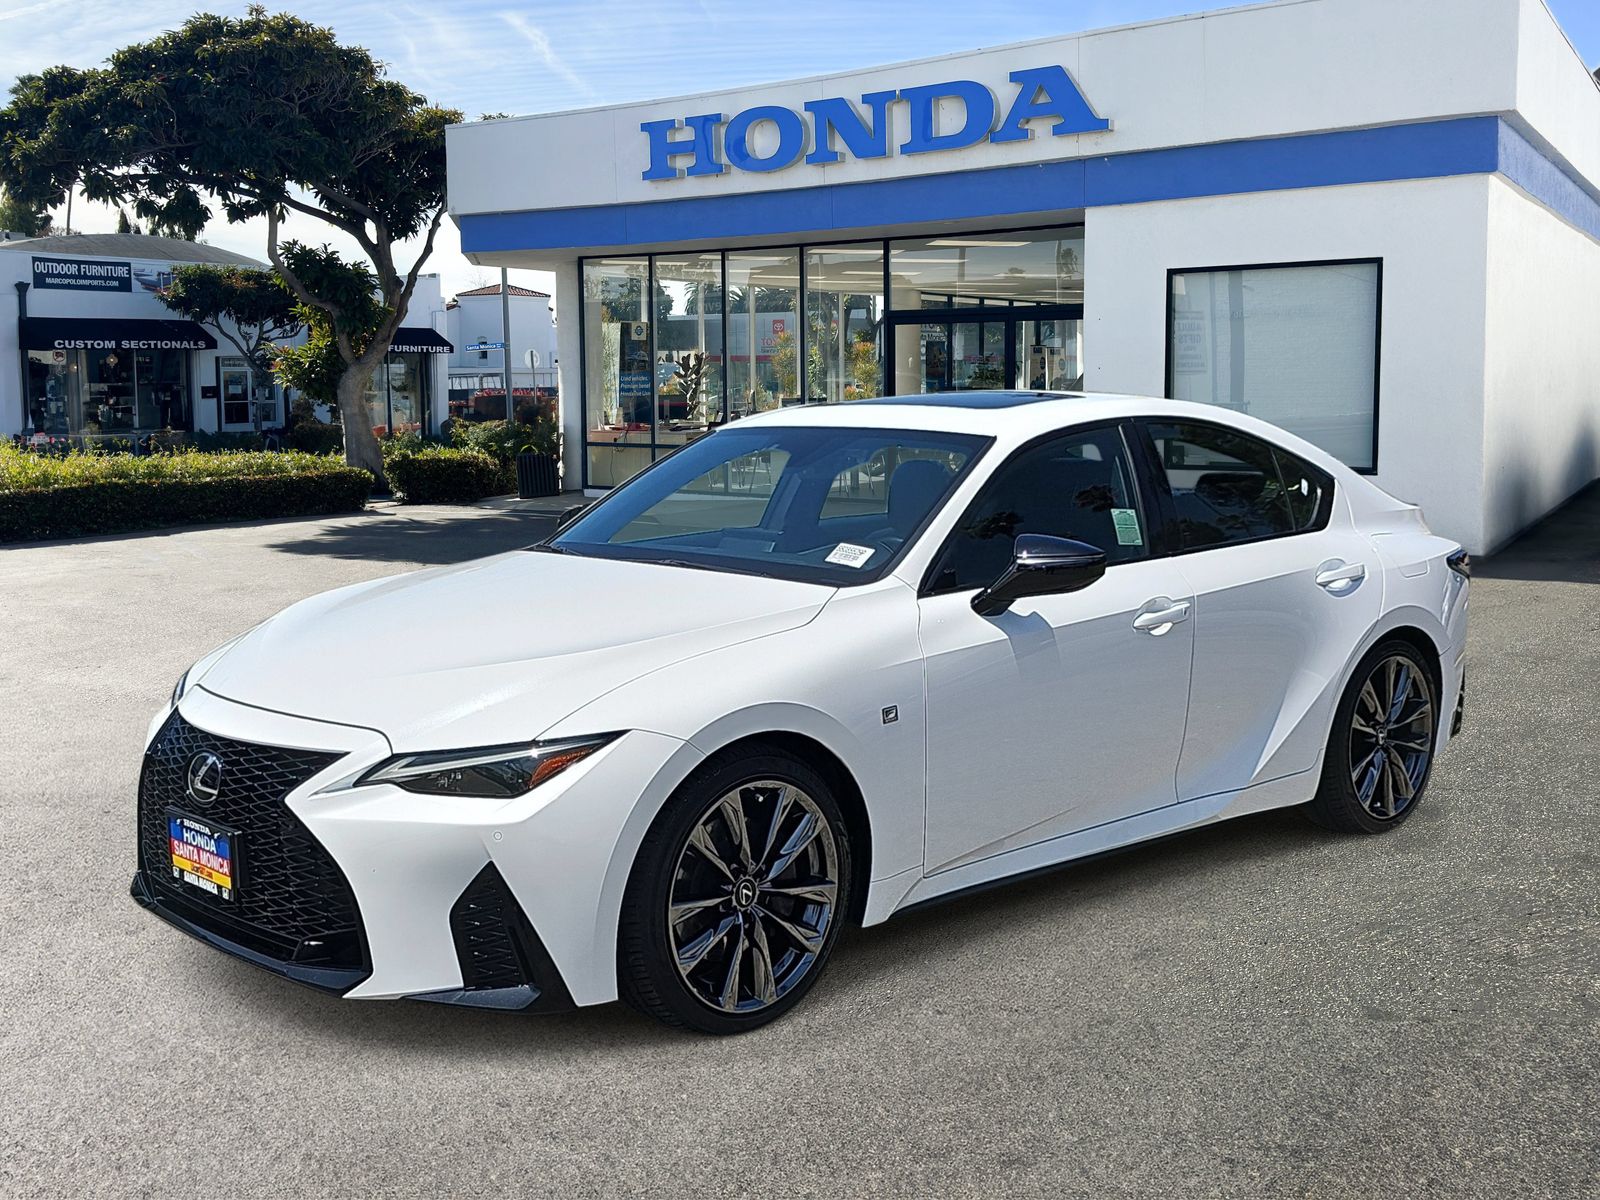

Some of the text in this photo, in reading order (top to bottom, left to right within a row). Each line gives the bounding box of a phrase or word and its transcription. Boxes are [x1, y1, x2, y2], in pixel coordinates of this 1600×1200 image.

[640, 65, 1112, 182] HONDA
[34, 261, 130, 277] OUTDOOR FURNITURE
[45, 277, 119, 287] MARCOPOLOIMPORTS.COM
[54, 339, 206, 349] CUSTOM SECTIONALS
[388, 344, 450, 353] FURNITURE
[183, 828, 217, 853] HONDA
[173, 839, 200, 863] SANTA
[199, 850, 231, 876] MONICA
